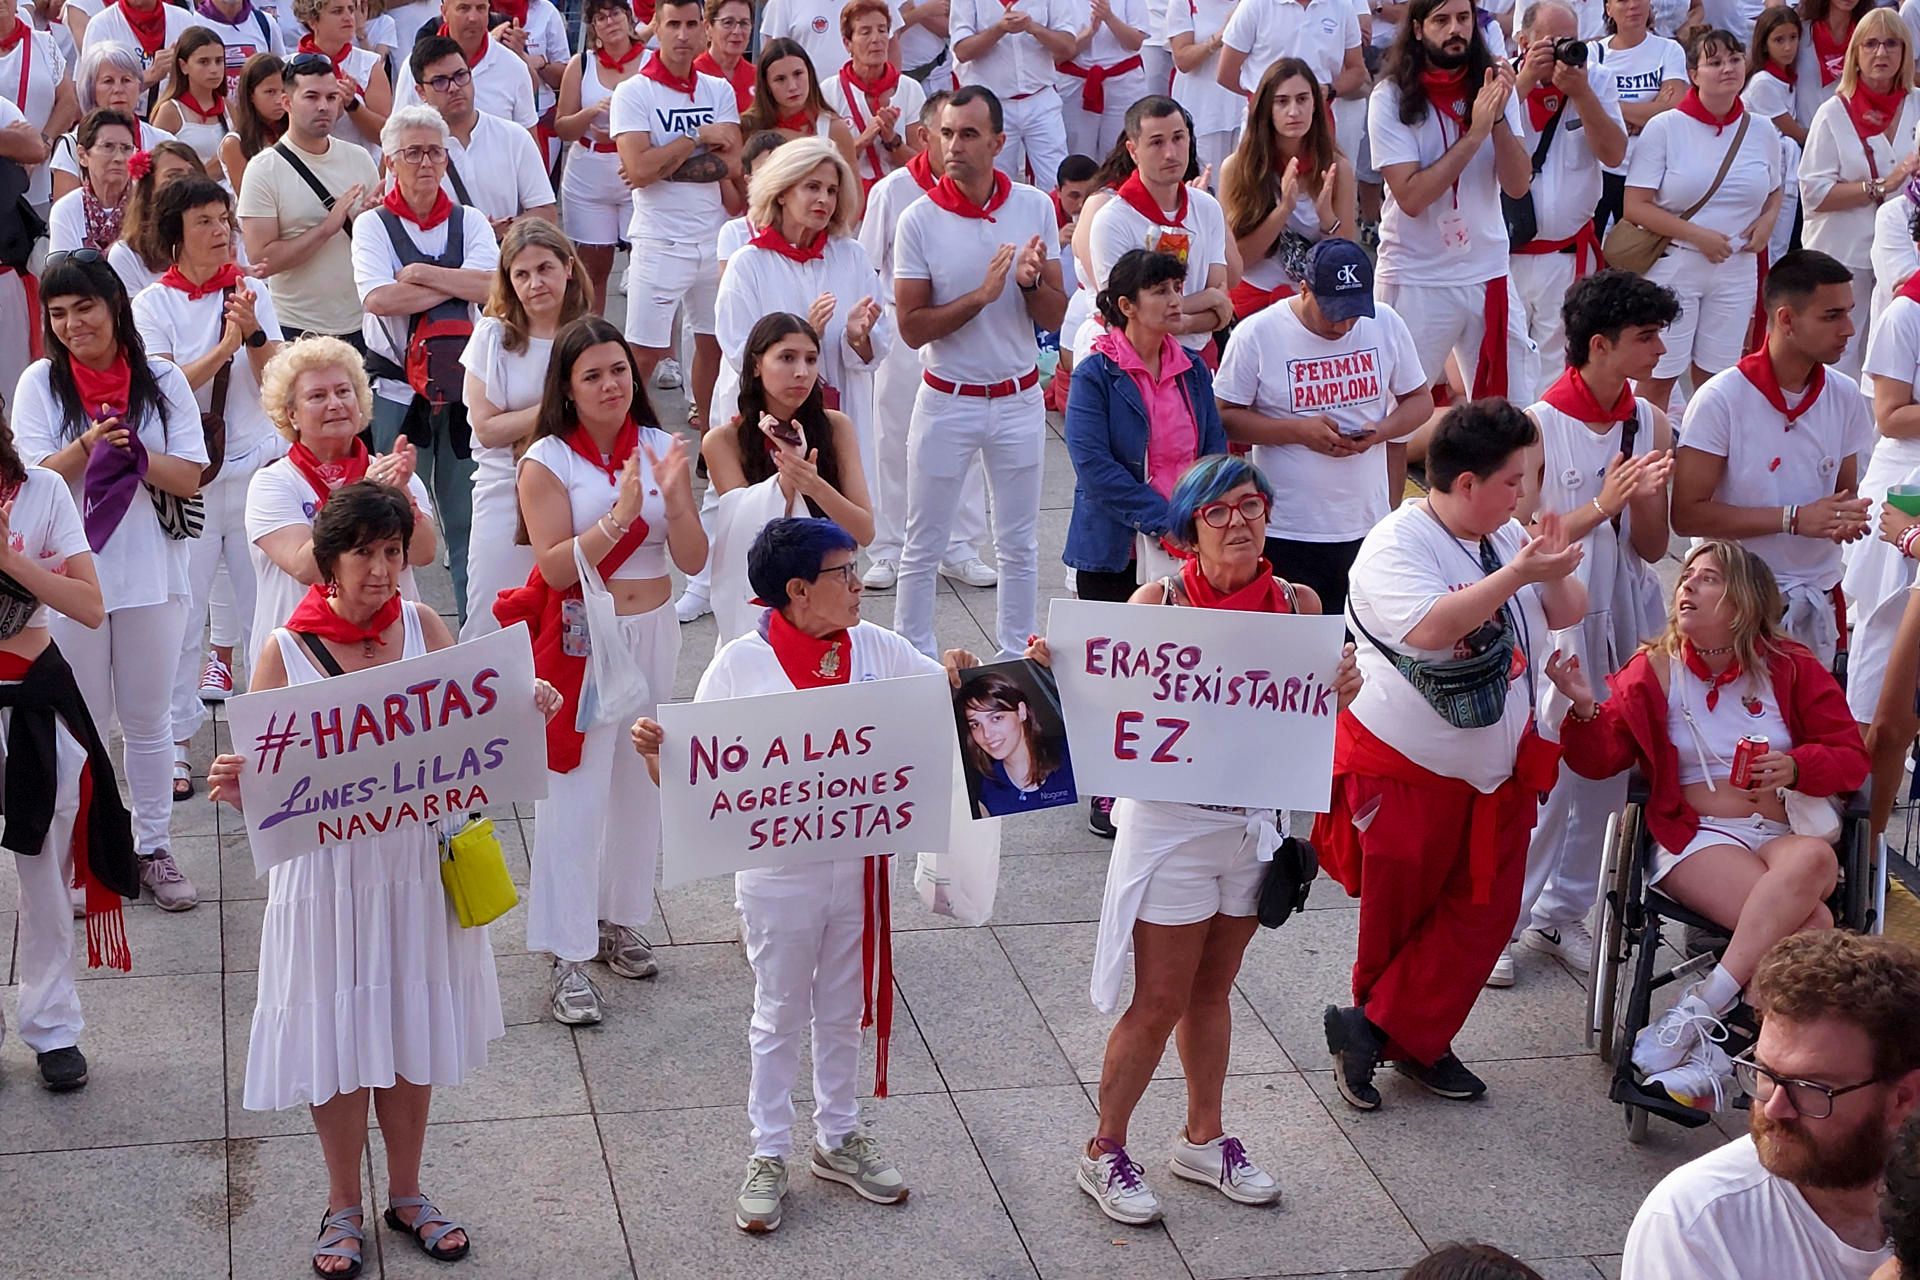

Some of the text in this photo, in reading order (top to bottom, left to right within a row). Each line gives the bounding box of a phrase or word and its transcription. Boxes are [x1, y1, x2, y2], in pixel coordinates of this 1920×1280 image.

[656, 107, 714, 132] VANS
[1295, 376, 1378, 407] PAMPLONA
[1085, 637, 1202, 679] ERASO
[762, 736, 789, 768] A
[804, 726, 876, 761] LAS
[318, 784, 488, 845] NAVARRA
